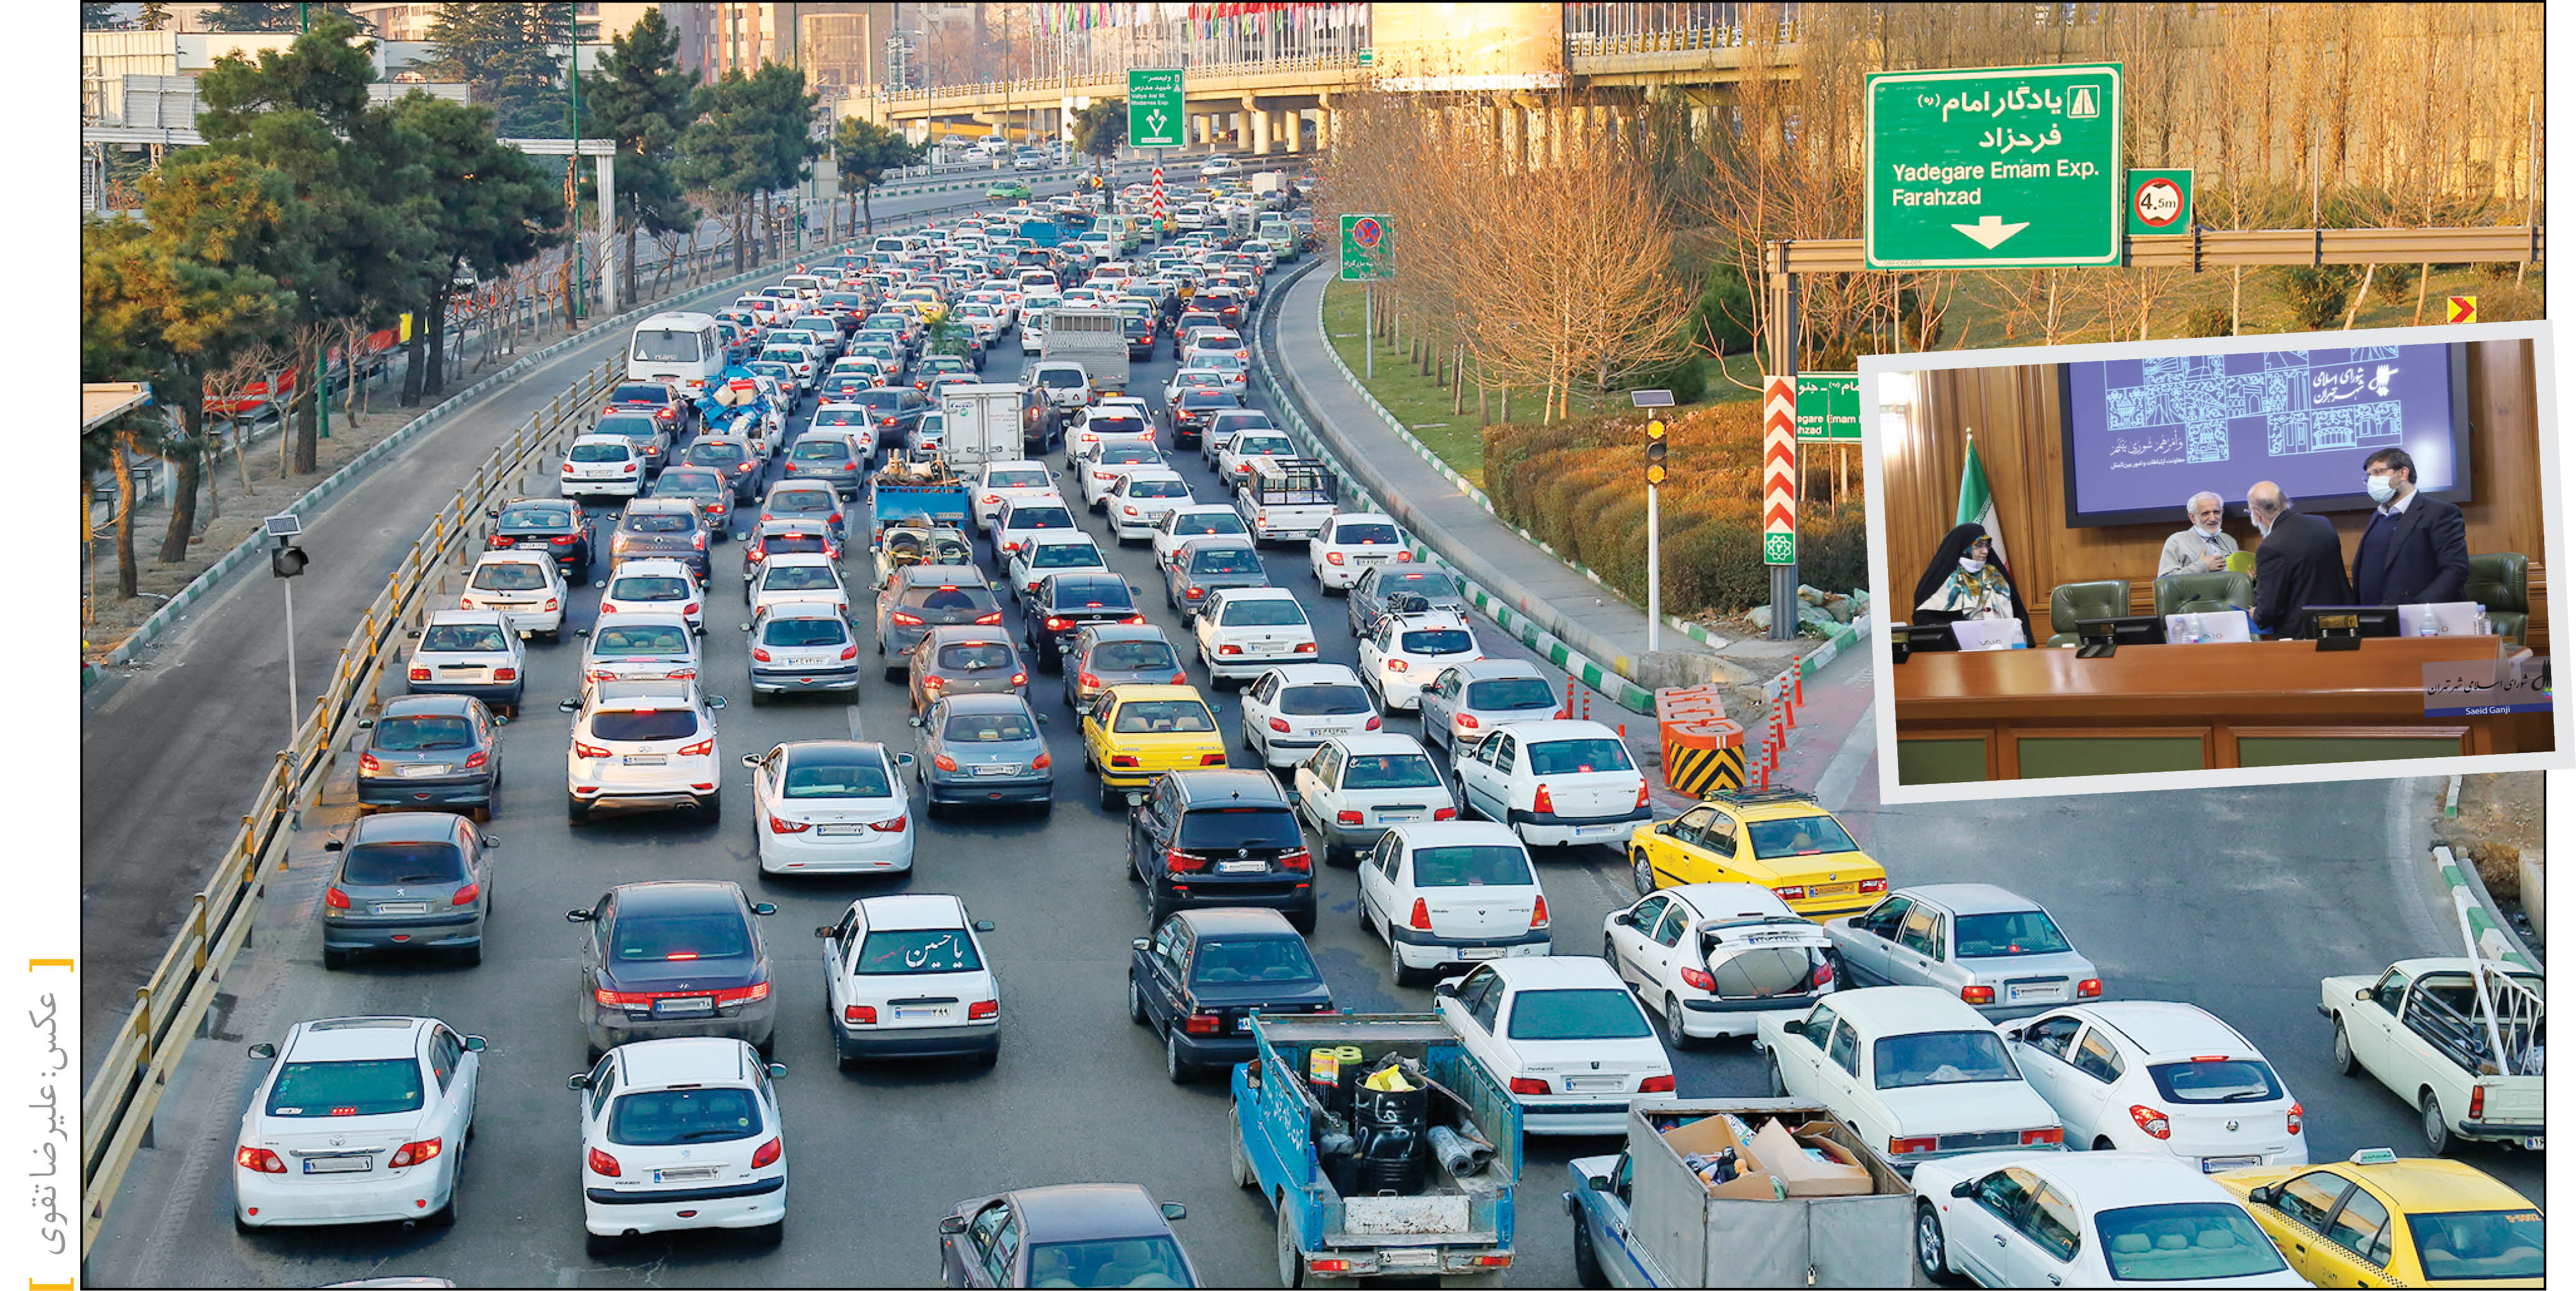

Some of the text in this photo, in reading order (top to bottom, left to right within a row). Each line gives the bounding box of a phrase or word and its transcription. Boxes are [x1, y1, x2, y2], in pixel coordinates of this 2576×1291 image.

[1943, 91, 1990, 122] امام
[1991, 86, 2063, 118] یادگار
[1979, 123, 2062, 154] فرحزاد
[1892, 158, 2100, 185] Yadegare Emam Exp.
[1892, 188, 1982, 206] Farahzad
